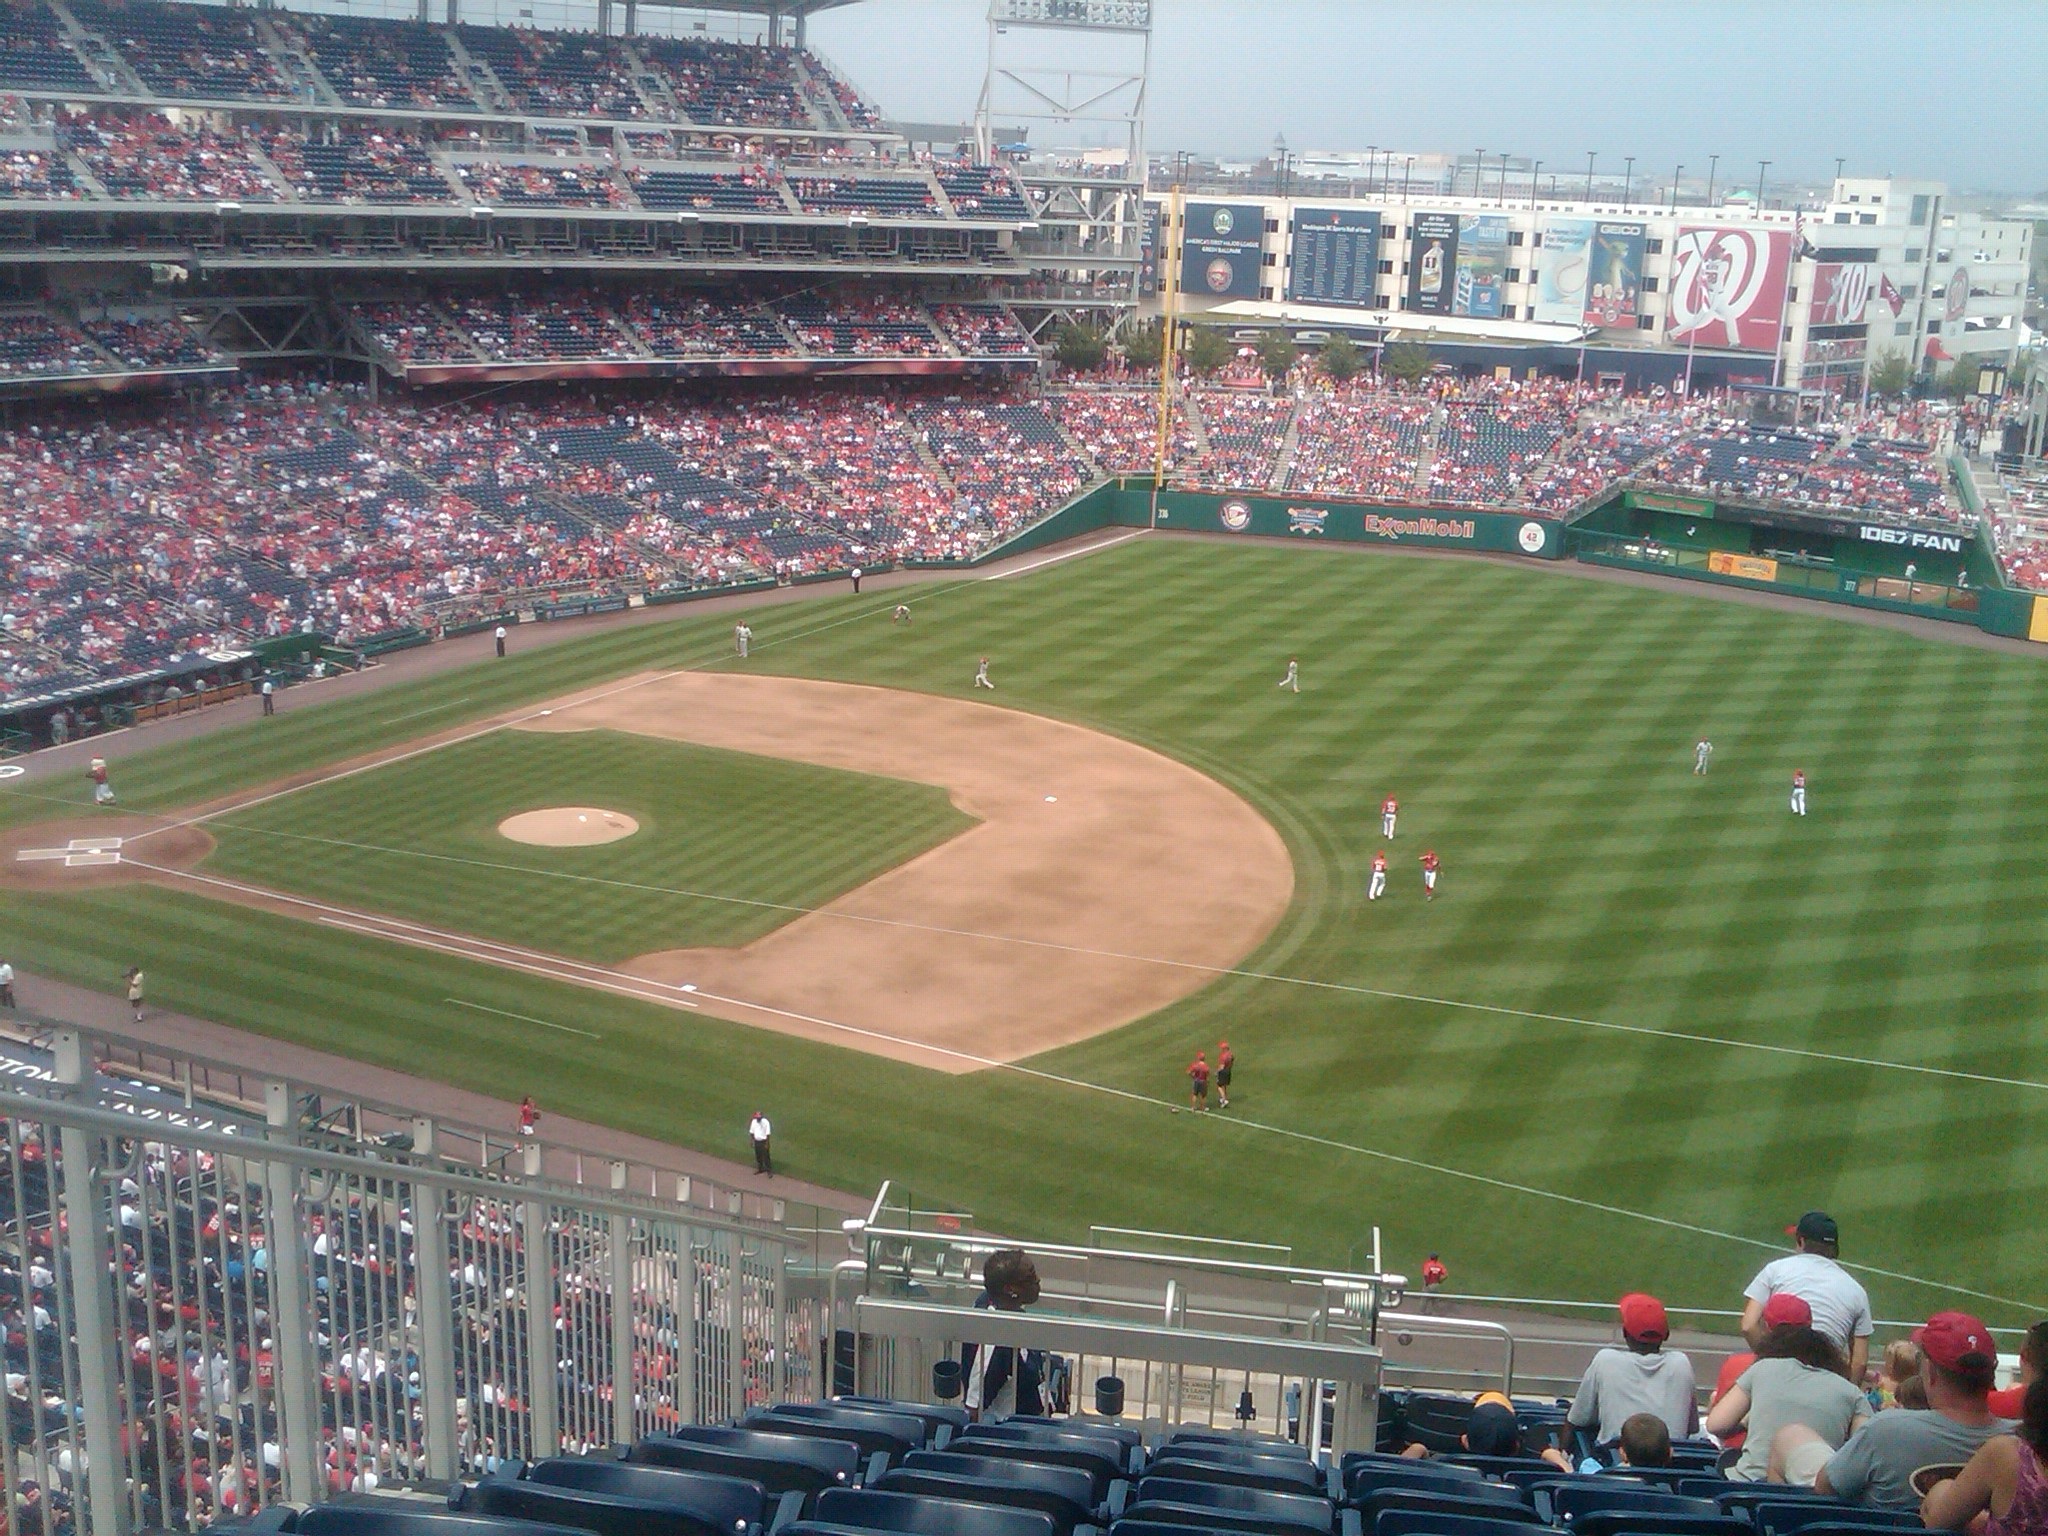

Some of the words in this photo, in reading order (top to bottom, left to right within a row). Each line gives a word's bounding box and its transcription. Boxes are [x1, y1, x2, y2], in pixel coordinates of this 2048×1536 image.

[1600, 224, 1640, 235] GEICO
[1365, 514, 1475, 539] ExxonMobil
[1526, 533, 1538, 542] 42
[1912, 533, 1961, 552] FAN
